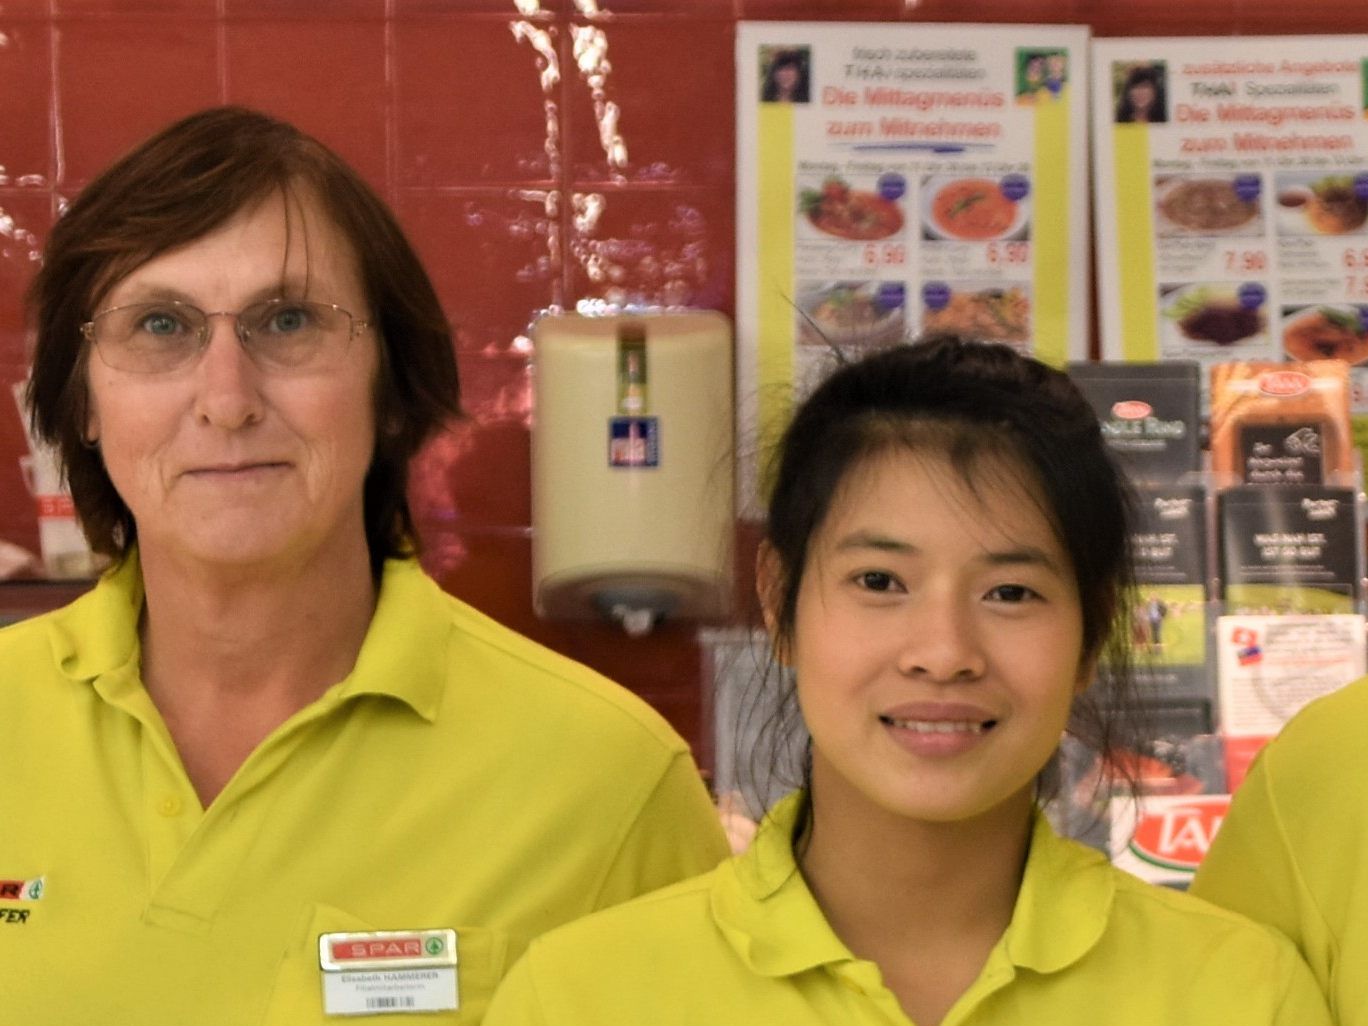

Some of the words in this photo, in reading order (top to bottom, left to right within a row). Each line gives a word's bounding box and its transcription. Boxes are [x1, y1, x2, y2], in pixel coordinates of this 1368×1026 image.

[821, 86, 857, 106] Die
[863, 86, 1005, 111] Mittagmenüs
[1175, 104, 1210, 123] Die
[1216, 101, 1356, 128] Mittagmenüs
[825, 121, 873, 137] zum
[879, 116, 1002, 138] Mitnehmen
[1179, 138, 1228, 154] zum
[1233, 132, 1354, 152] Mitnehmen
[351, 941, 420, 957] SPAR
